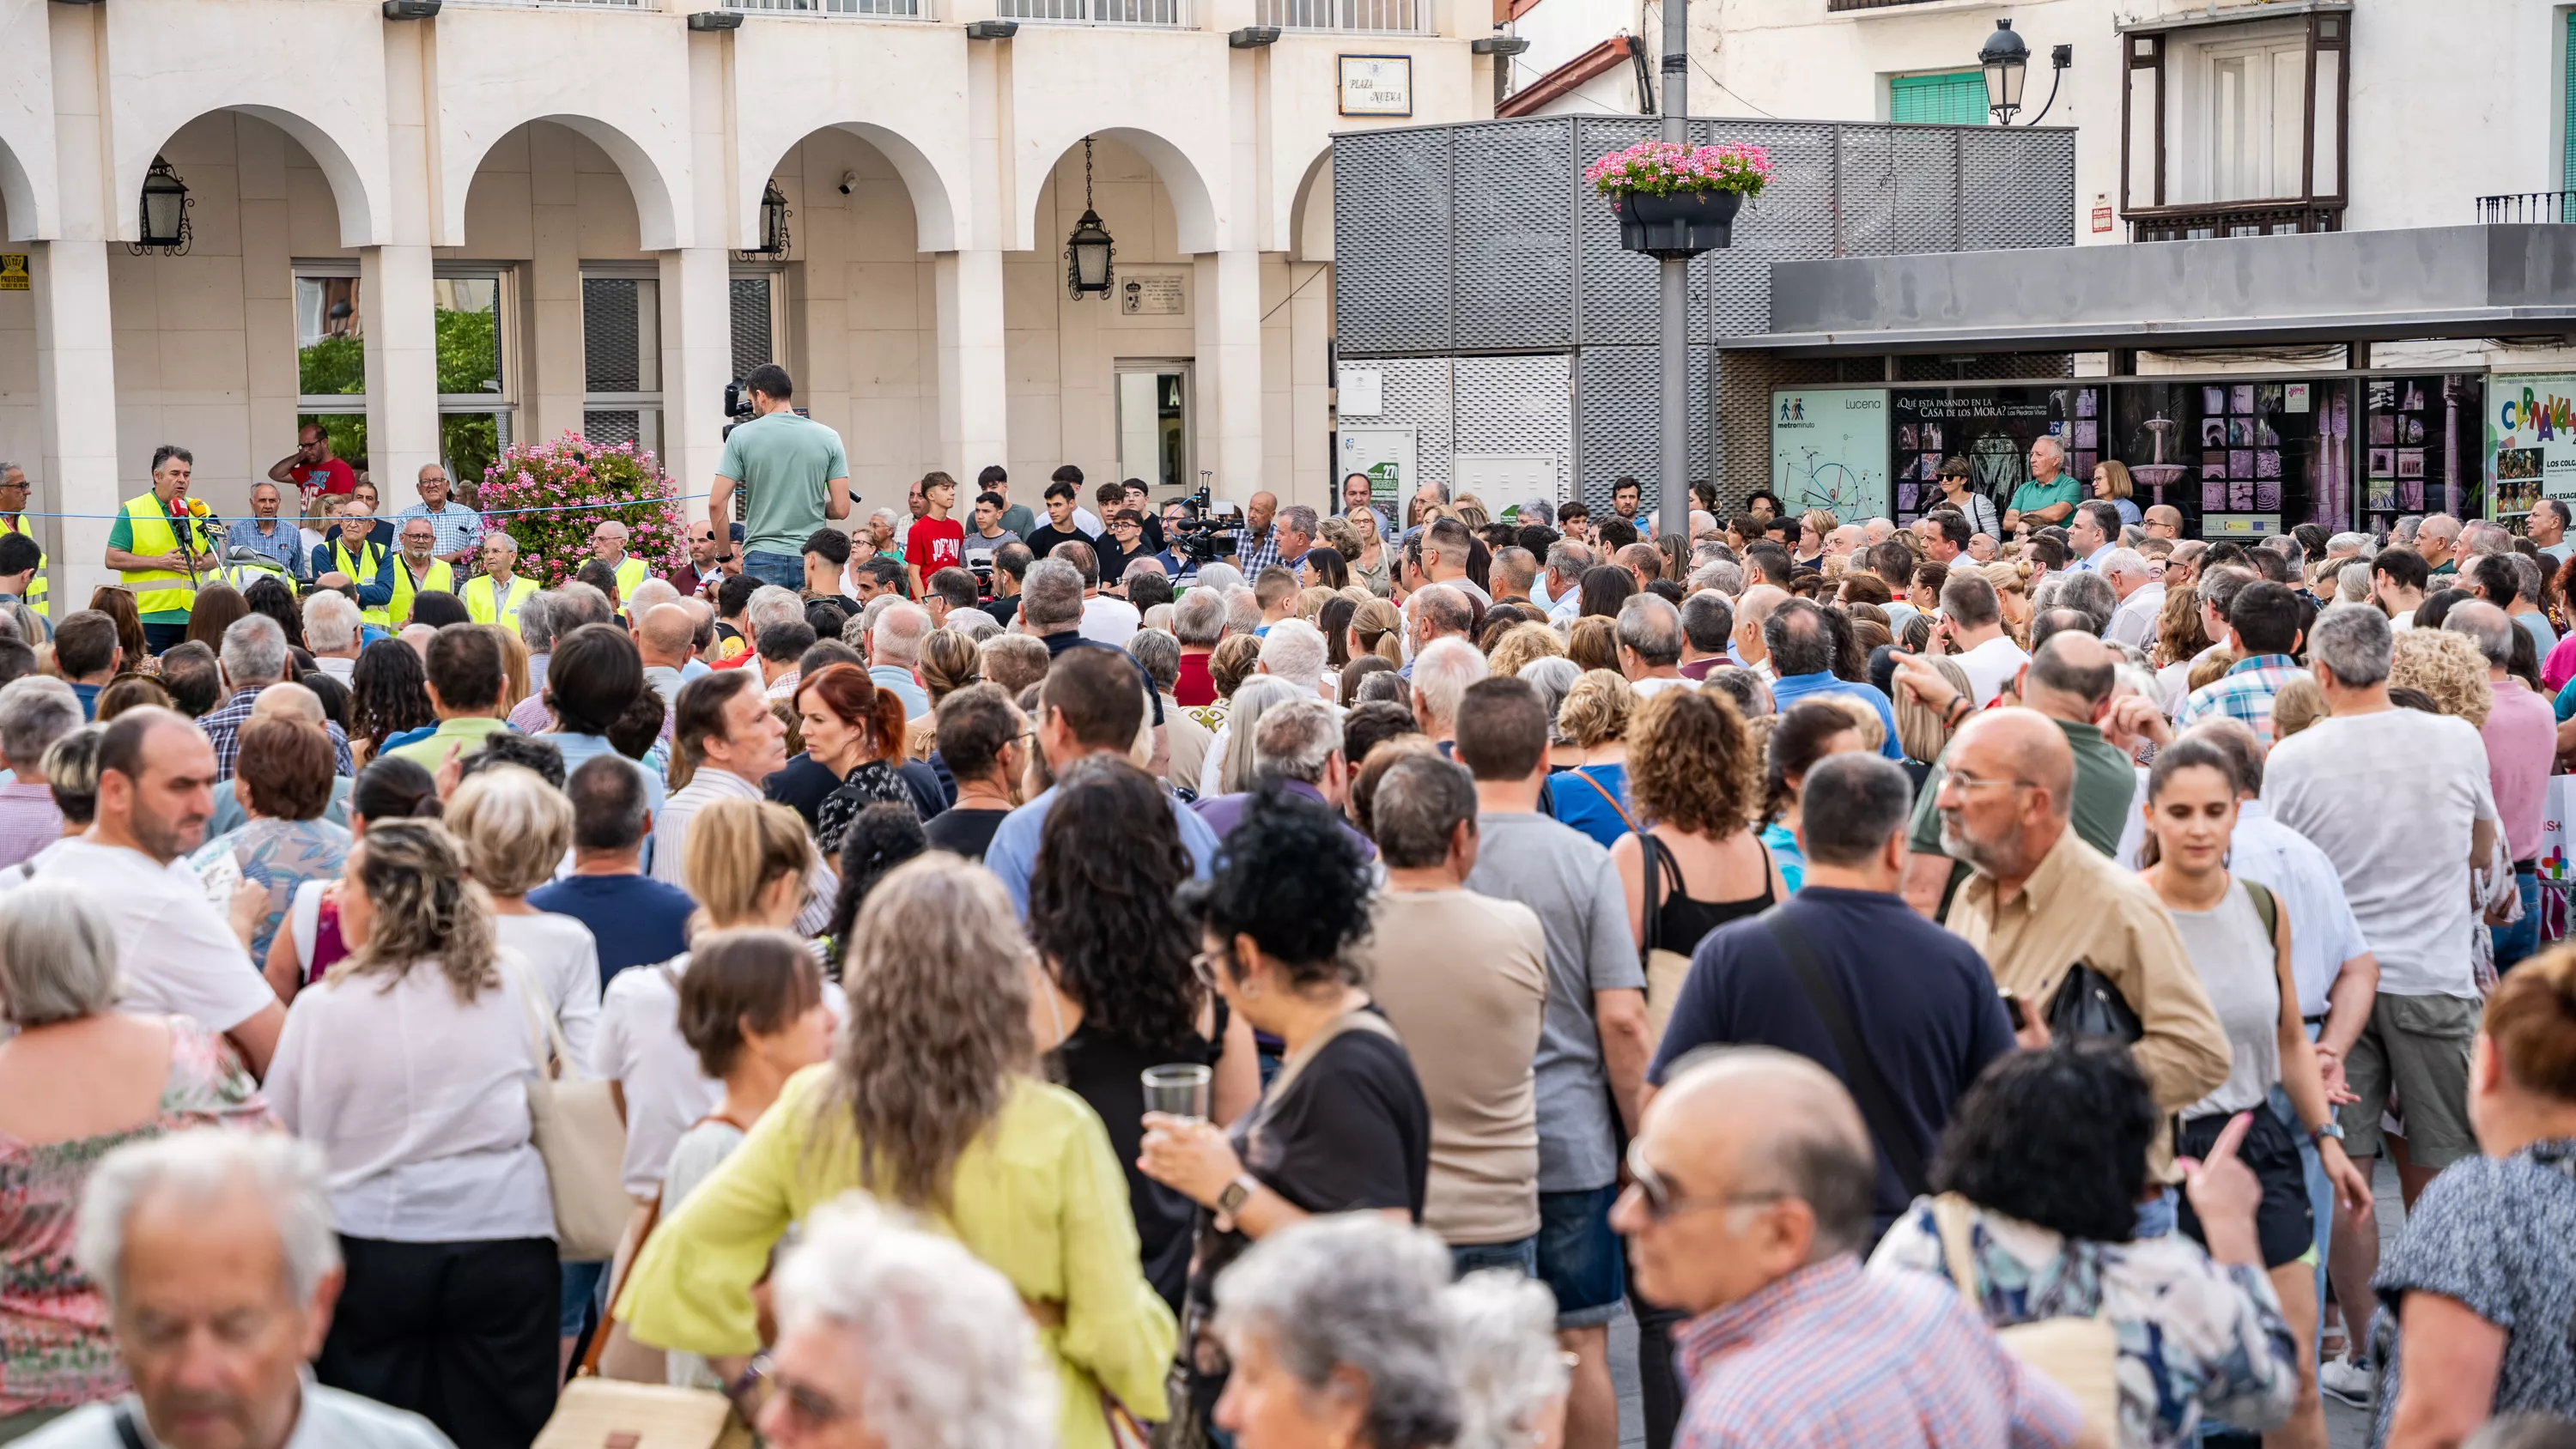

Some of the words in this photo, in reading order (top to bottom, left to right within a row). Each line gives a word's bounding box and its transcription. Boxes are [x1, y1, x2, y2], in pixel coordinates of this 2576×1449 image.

[1349, 79, 1373, 89] PLAZA
[1370, 91, 1401, 103] NUEVA
[1845, 398, 1880, 409] Lucena
[1897, 397, 1917, 409] ¿QUÉ
[1918, 398, 1934, 407] ESTÁ
[1971, 398, 1981, 407] EN
[1920, 407, 1944, 417] CASA
[1947, 409, 1956, 417] DE
[1958, 409, 1971, 417] LOS
[1974, 406, 2006, 417] MORA?
[1382, 464, 1394, 479] 27
[1371, 480, 1397, 488] UCENA
